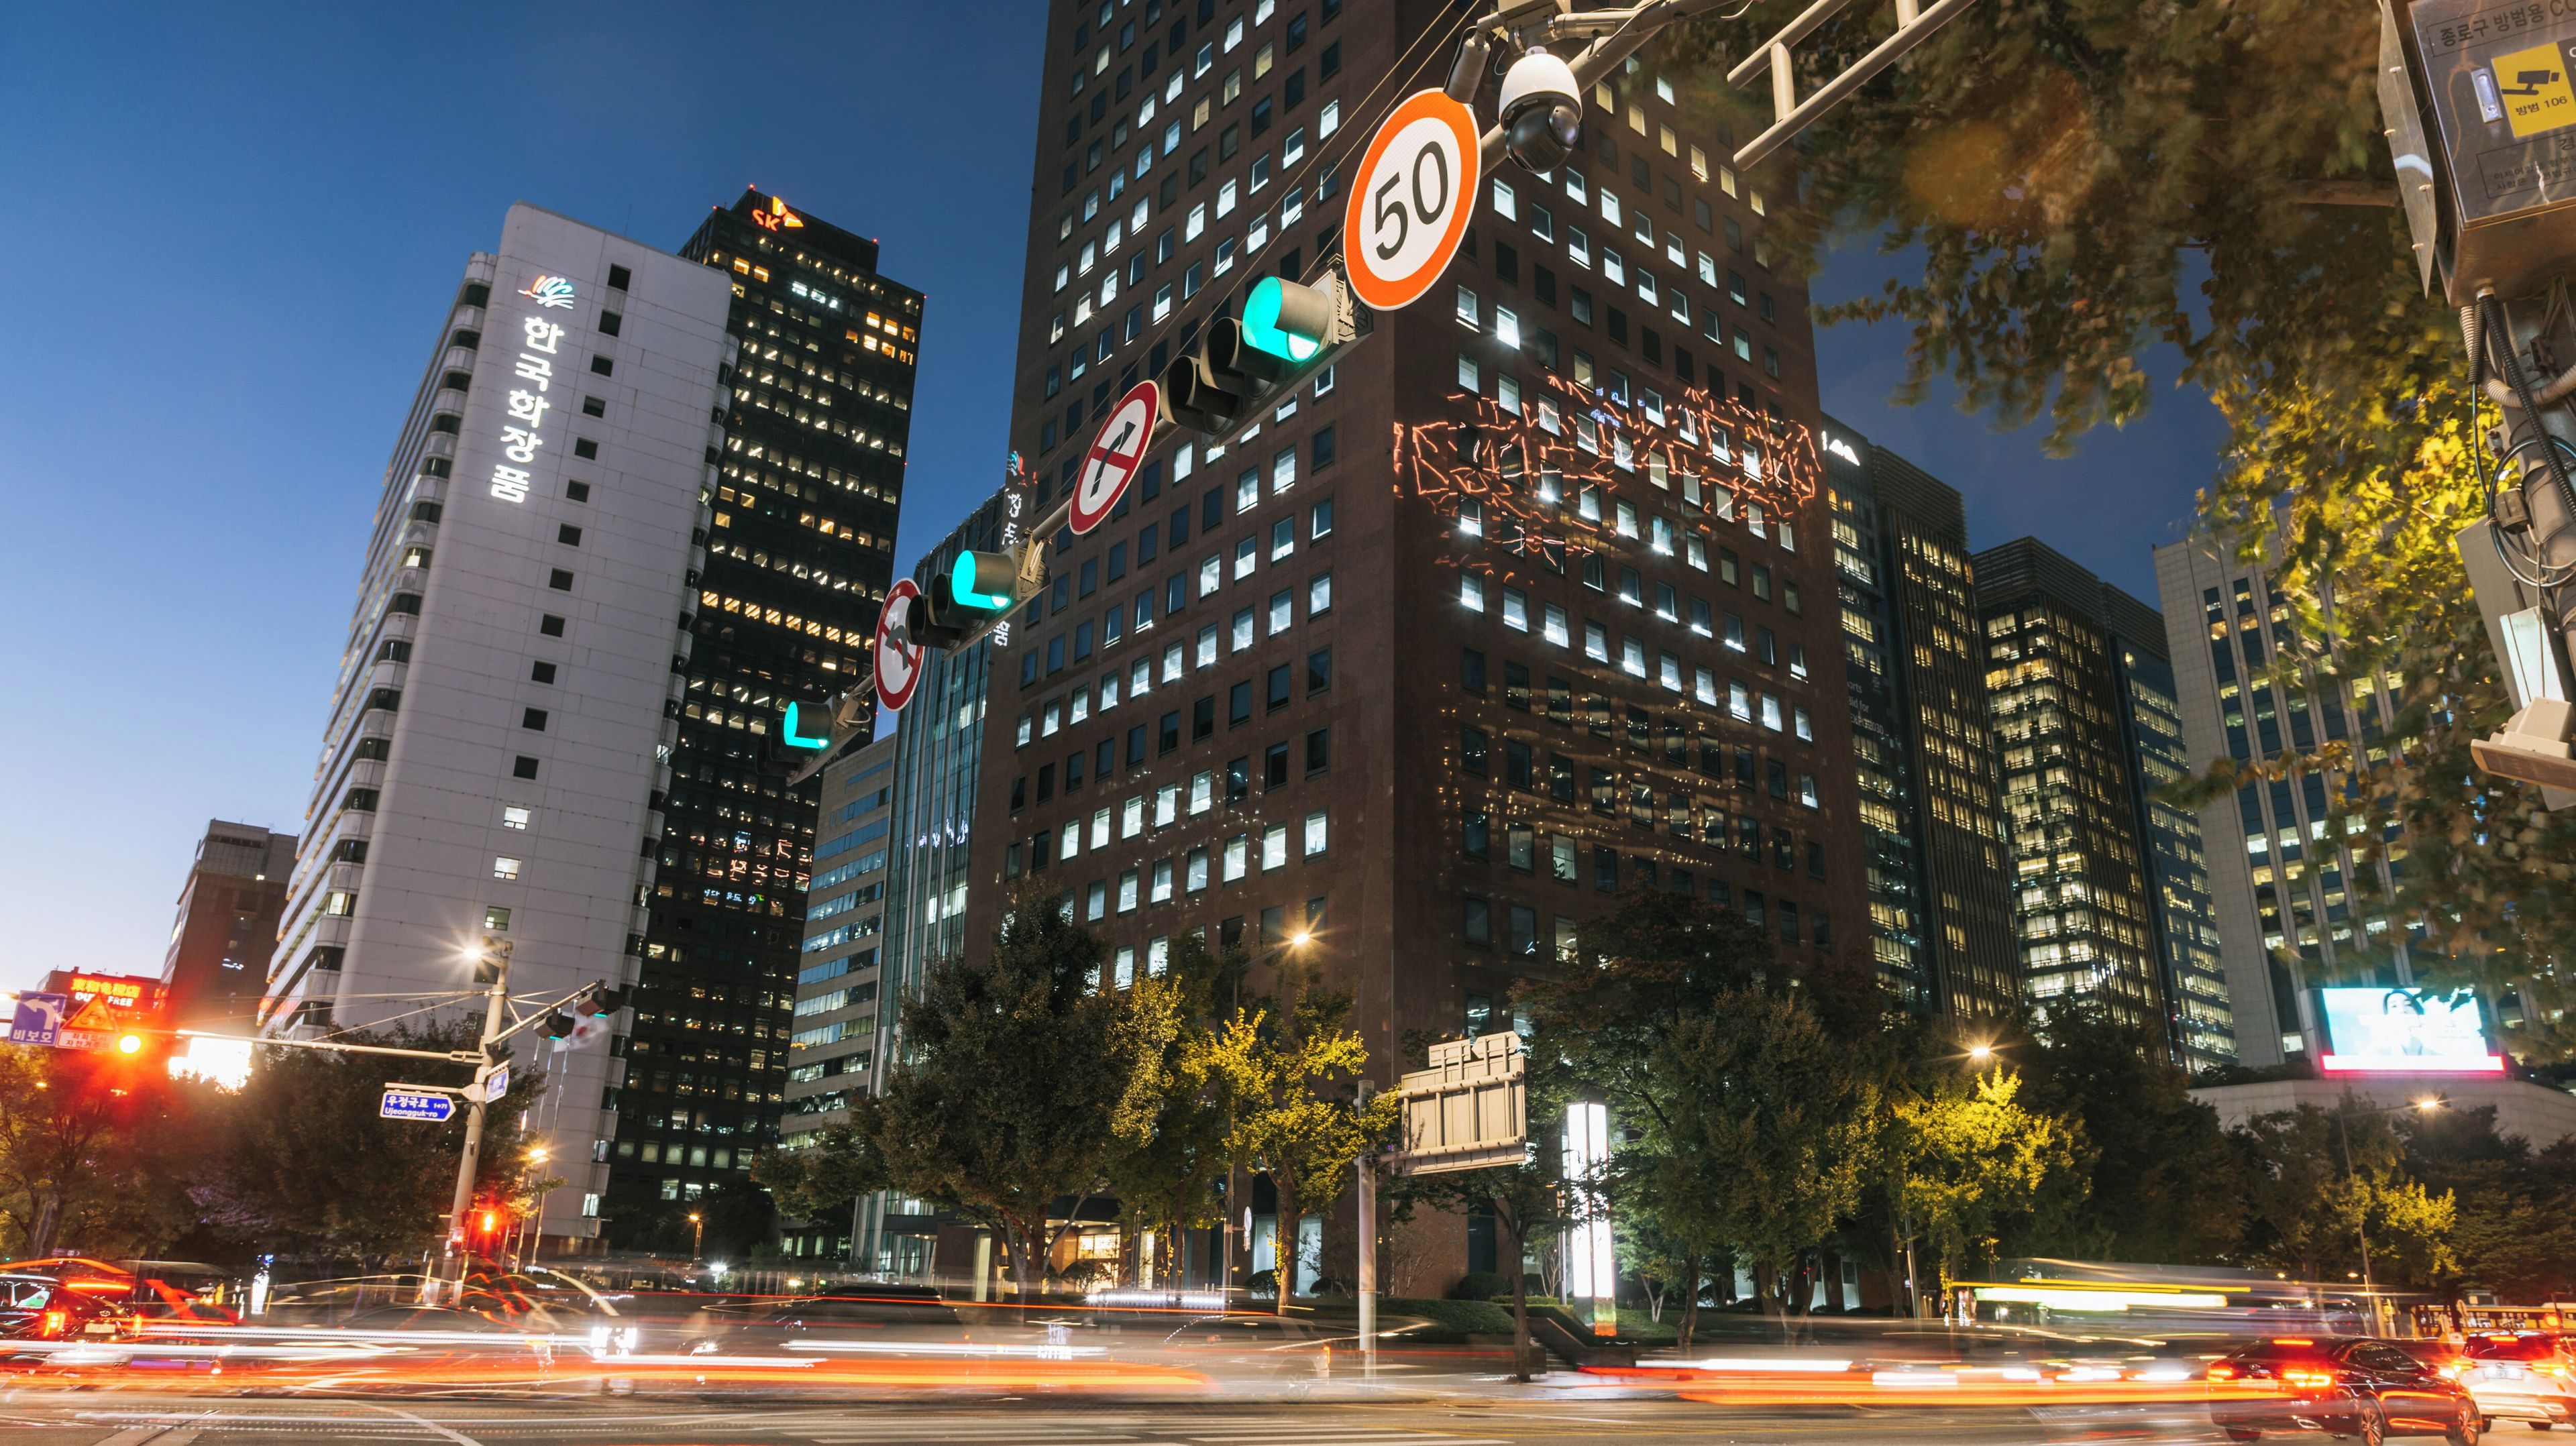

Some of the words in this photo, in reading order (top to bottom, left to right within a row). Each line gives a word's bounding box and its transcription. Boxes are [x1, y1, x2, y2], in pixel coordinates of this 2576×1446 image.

[2440, 19, 2489, 47] 종로구
[2493, 3, 2544, 32] 방범용
[2516, 102, 2540, 116] 방범
[2544, 95, 2568, 109] 106
[1375, 141, 1448, 260] 50
[752, 209, 781, 231] SK
[490, 317, 565, 504] 한국화장품
[107, 995, 134, 1007] FREE
[13, 1030, 52, 1043] 비보호
[384, 1107, 439, 1118] Ujeongguk-ro
